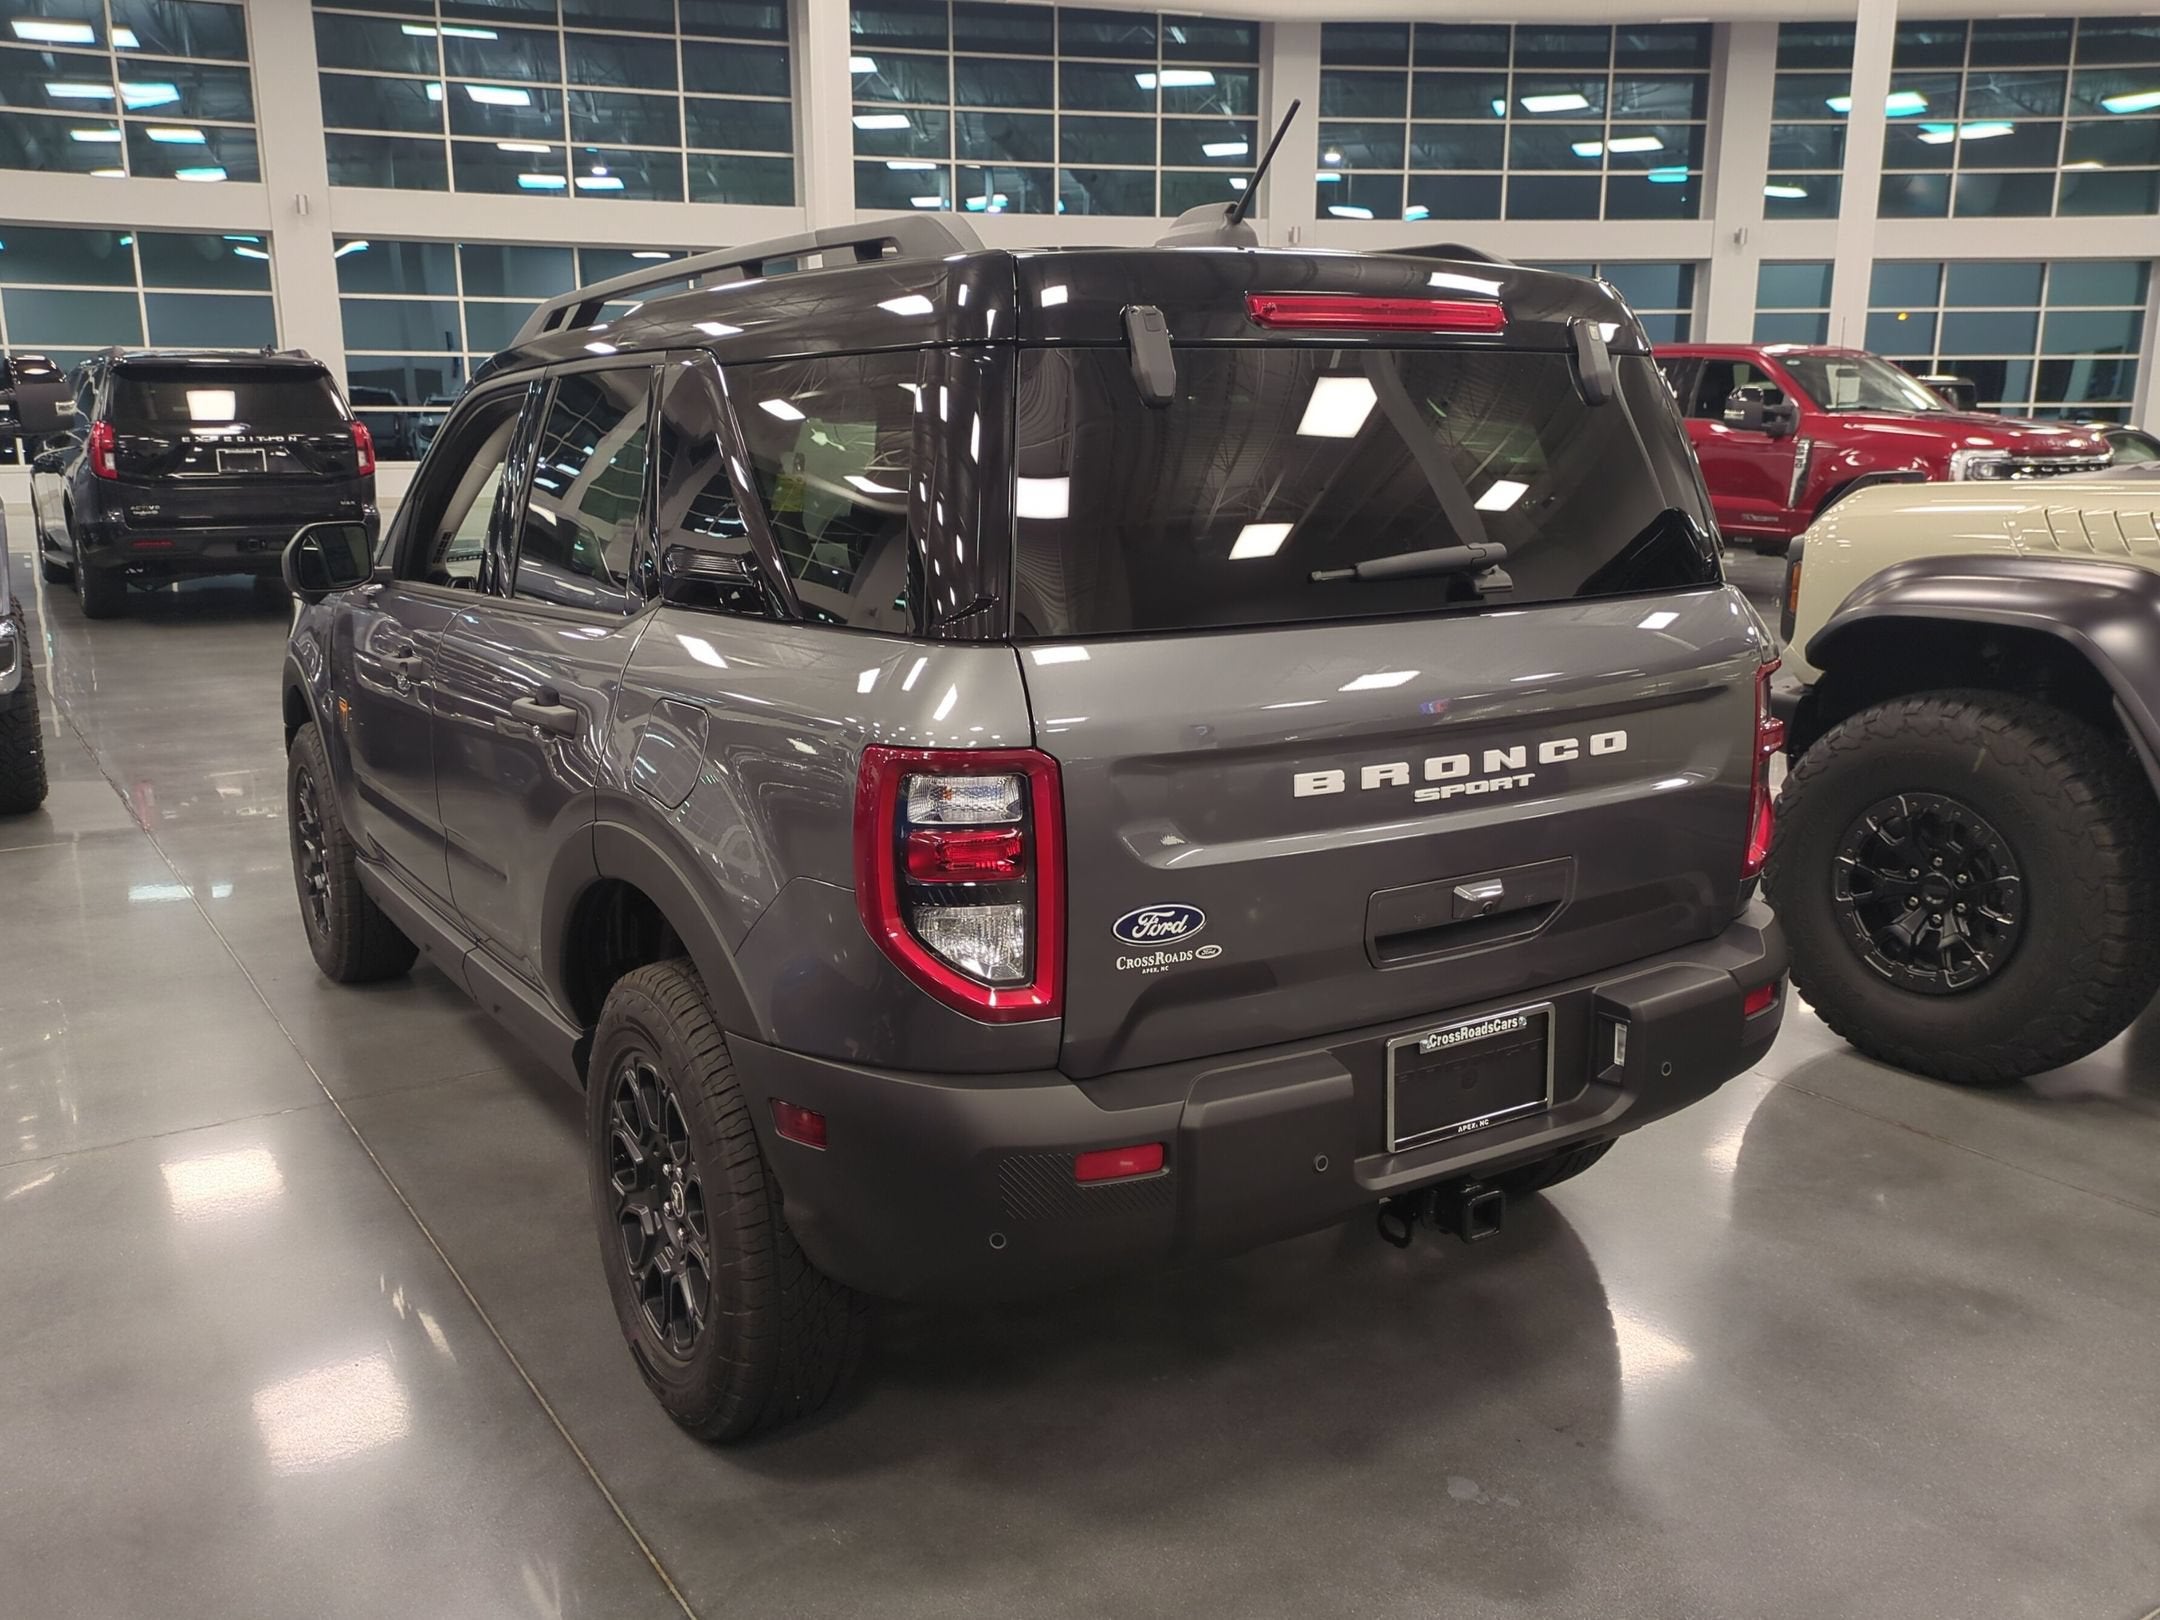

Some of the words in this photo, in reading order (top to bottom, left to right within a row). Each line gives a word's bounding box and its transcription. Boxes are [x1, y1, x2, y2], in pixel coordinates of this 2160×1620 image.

[1293, 729, 1628, 799] BRONCO
[1414, 773, 1536, 803] SPORT
[1131, 910, 1190, 939] Ford
[1428, 1016, 1519, 1048] CrossRoadsCars
[1479, 1119, 1489, 1127] NC
